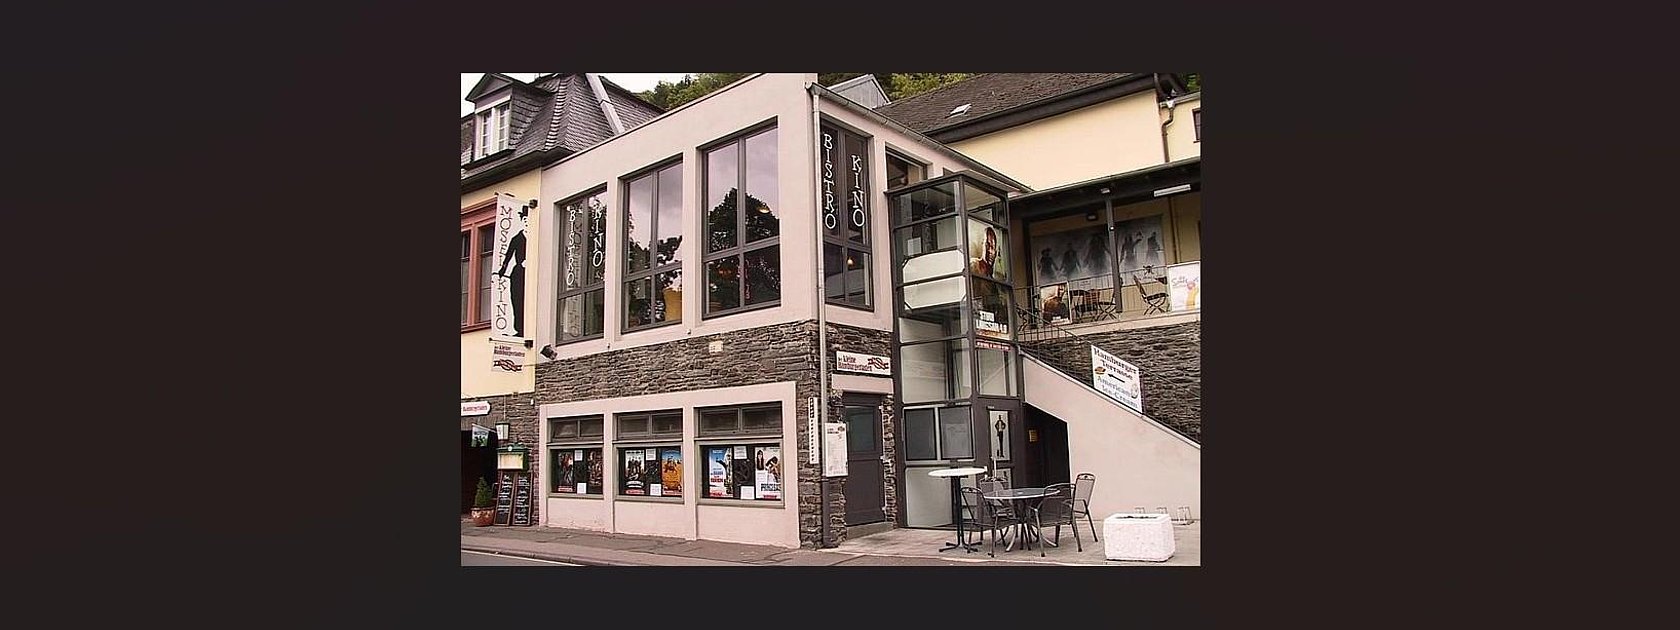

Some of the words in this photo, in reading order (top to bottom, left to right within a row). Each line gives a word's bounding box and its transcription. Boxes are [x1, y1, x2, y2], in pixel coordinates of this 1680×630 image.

[823, 133, 836, 229] BISTRO
[851, 154, 865, 227] KINO
[567, 209, 576, 285] BISTRO
[496, 278, 508, 330] KINO
[1093, 347, 1138, 375] Hamburger
[1100, 359, 1133, 381] Terrasse
